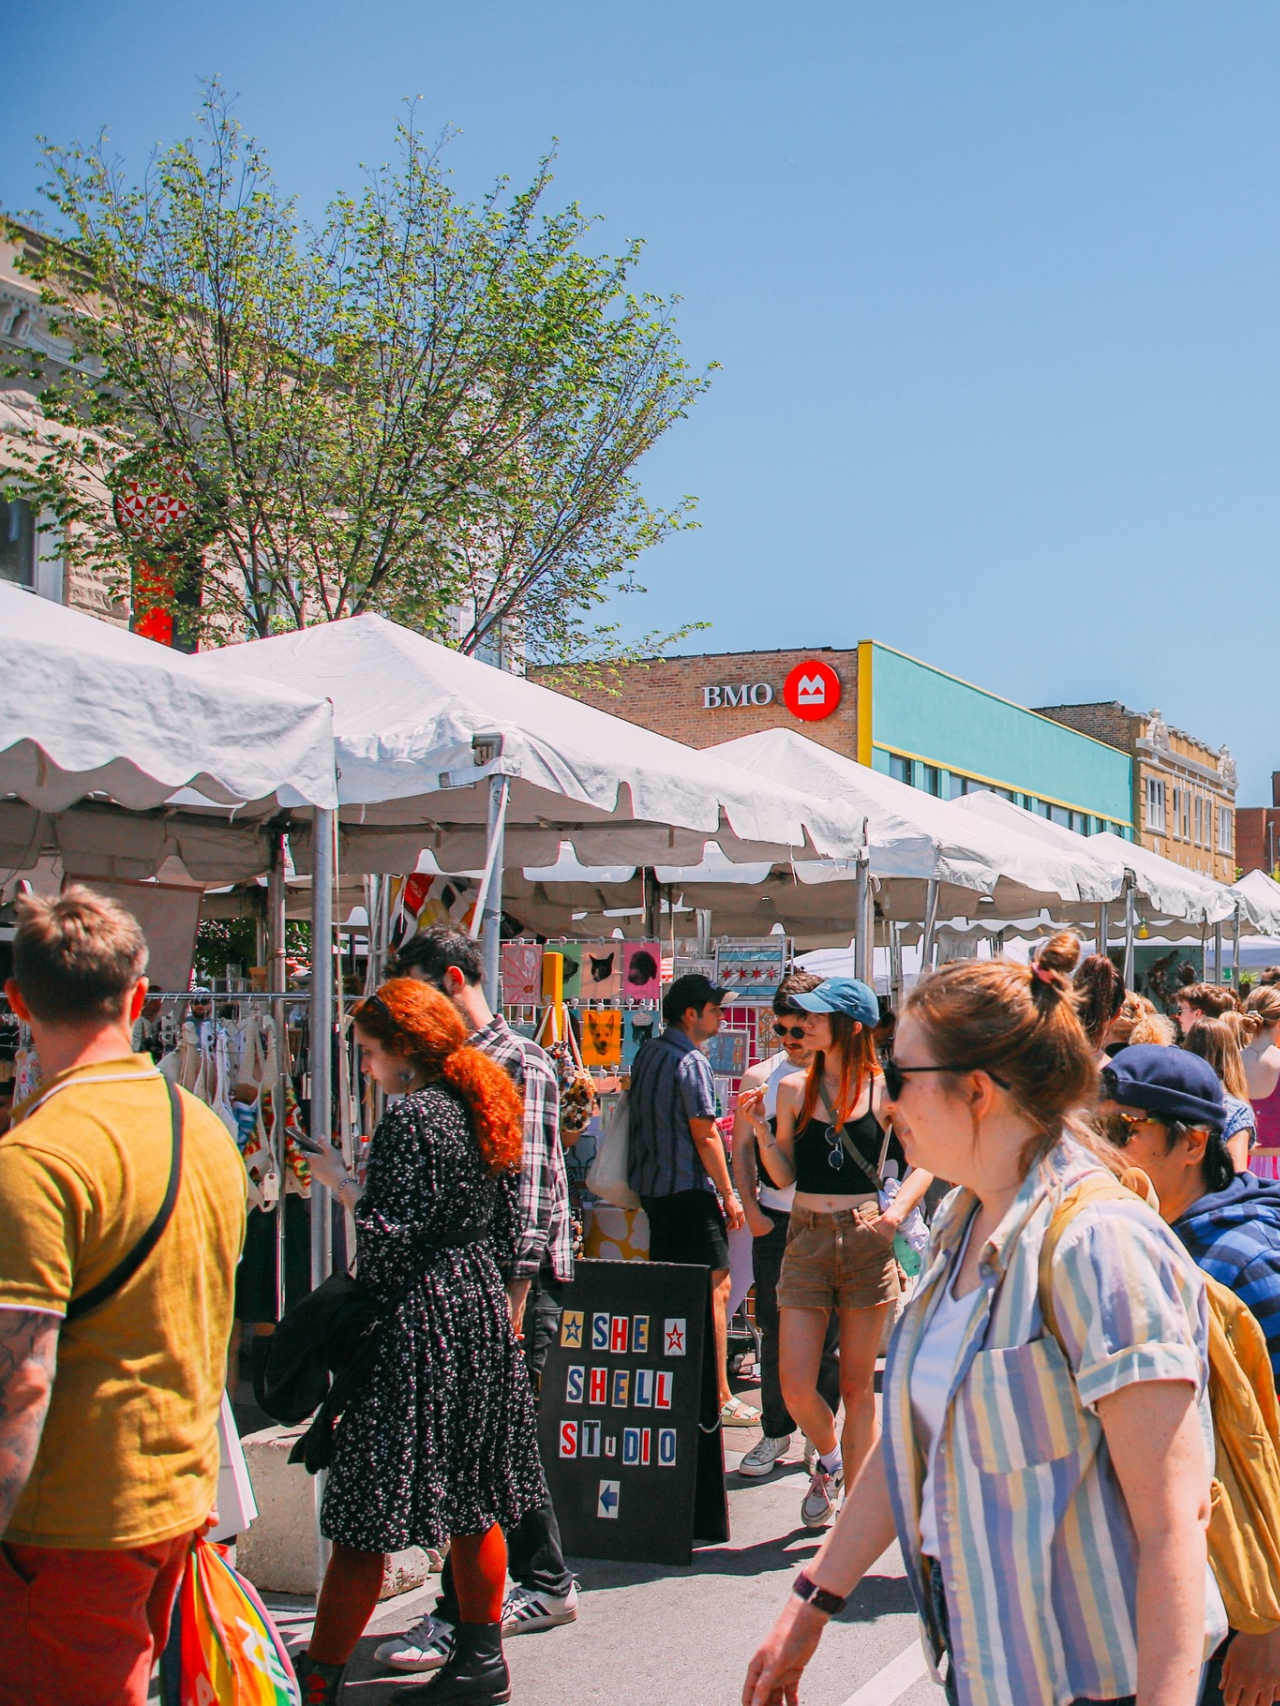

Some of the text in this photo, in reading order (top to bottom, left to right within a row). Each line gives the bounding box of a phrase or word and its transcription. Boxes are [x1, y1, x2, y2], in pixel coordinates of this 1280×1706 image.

[701, 683, 773, 709] BMO
[593, 1314, 648, 1352] SHE
[567, 1368, 670, 1407] SHELL
